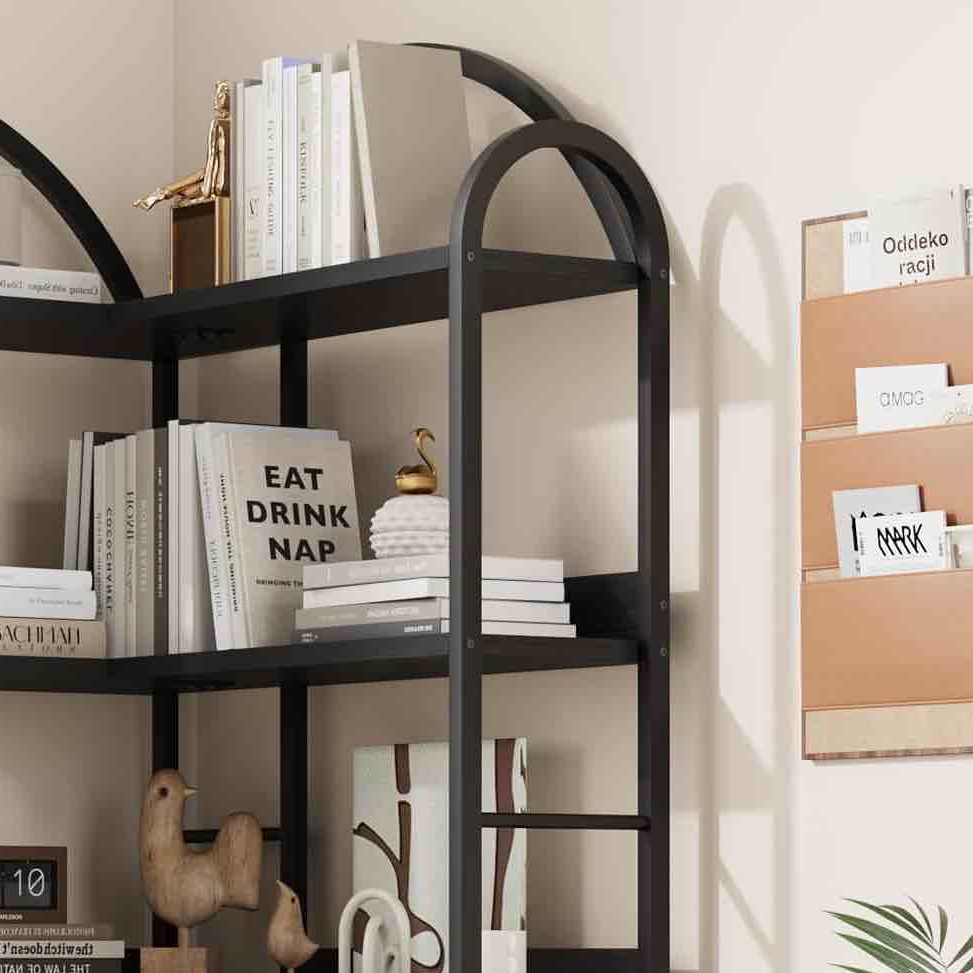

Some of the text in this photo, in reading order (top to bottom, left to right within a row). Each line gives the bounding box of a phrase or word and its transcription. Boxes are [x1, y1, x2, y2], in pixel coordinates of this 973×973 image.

[883, 231, 949, 254] Oddeko
[899, 253, 936, 276] racji
[264, 465, 324, 491] EAT
[246, 500, 352, 529] DRINK
[268, 536, 336, 562] NAP
[876, 523, 927, 557] MARK
[13, 867, 45, 896] 10
